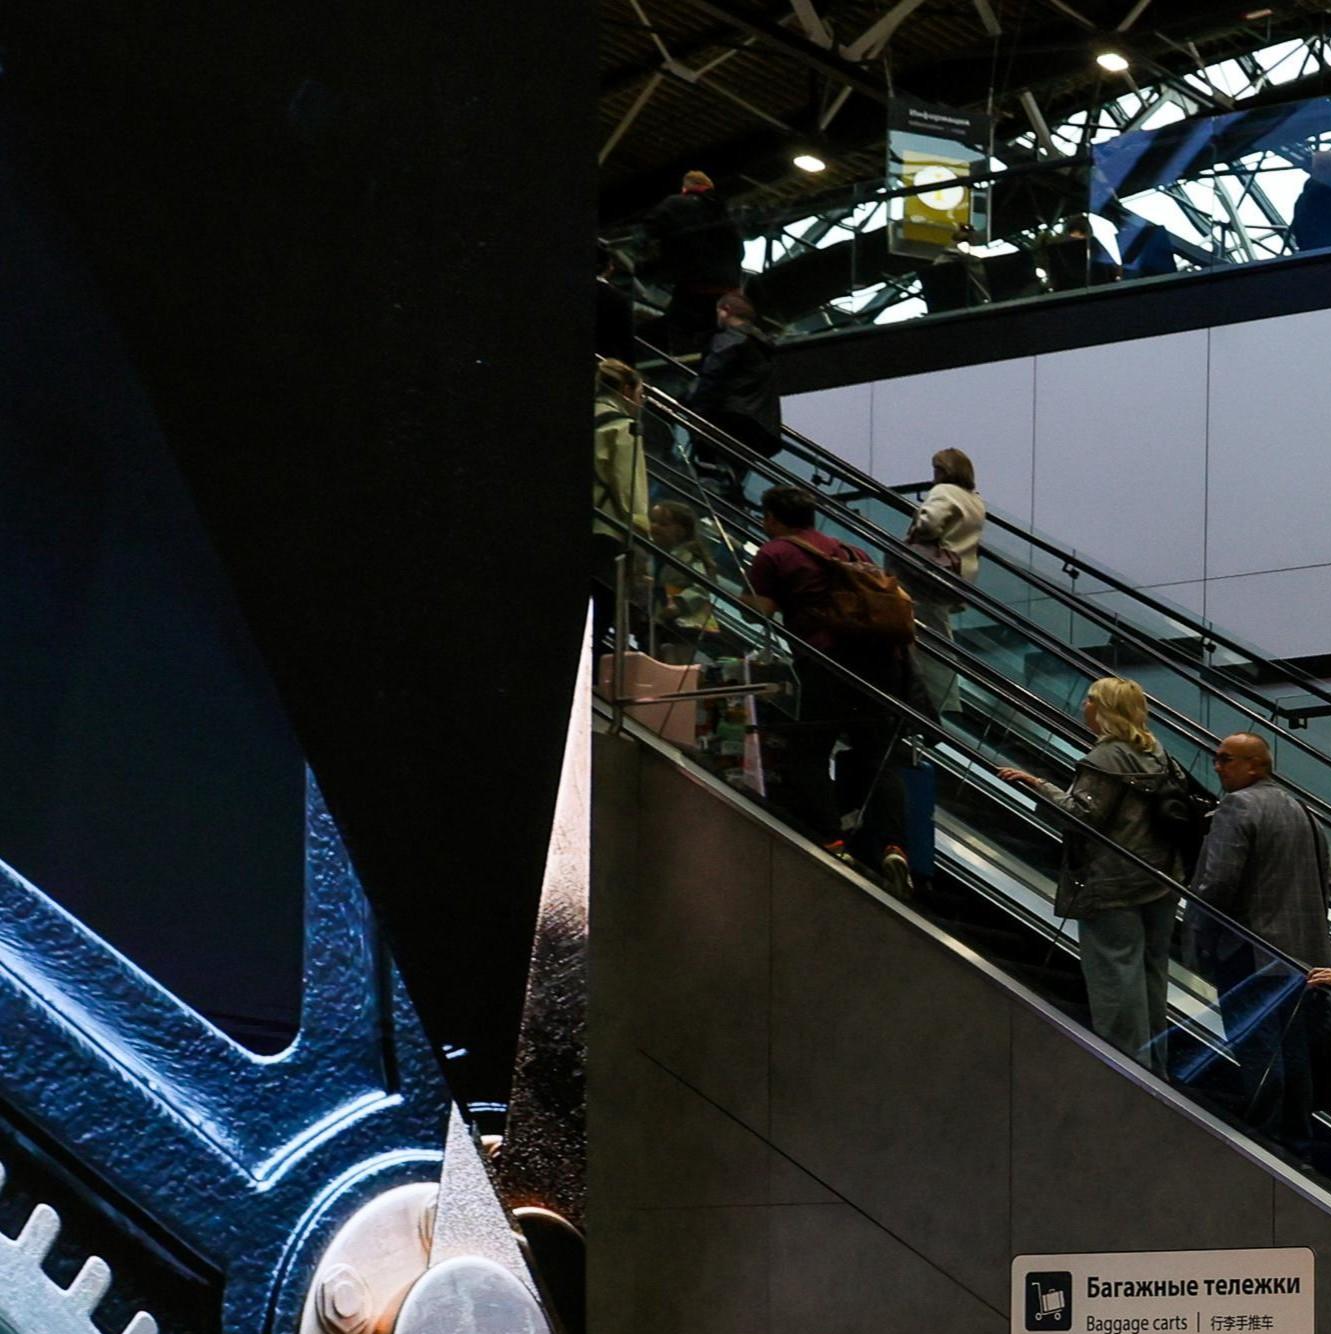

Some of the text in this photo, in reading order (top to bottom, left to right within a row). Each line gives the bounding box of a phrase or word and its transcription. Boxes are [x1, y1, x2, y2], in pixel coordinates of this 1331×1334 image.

[1086, 1276, 1301, 1299] Багажные тележки
[1086, 1314, 1188, 1334] Baggage carts
[1210, 1314, 1274, 1332] 行李手推车
